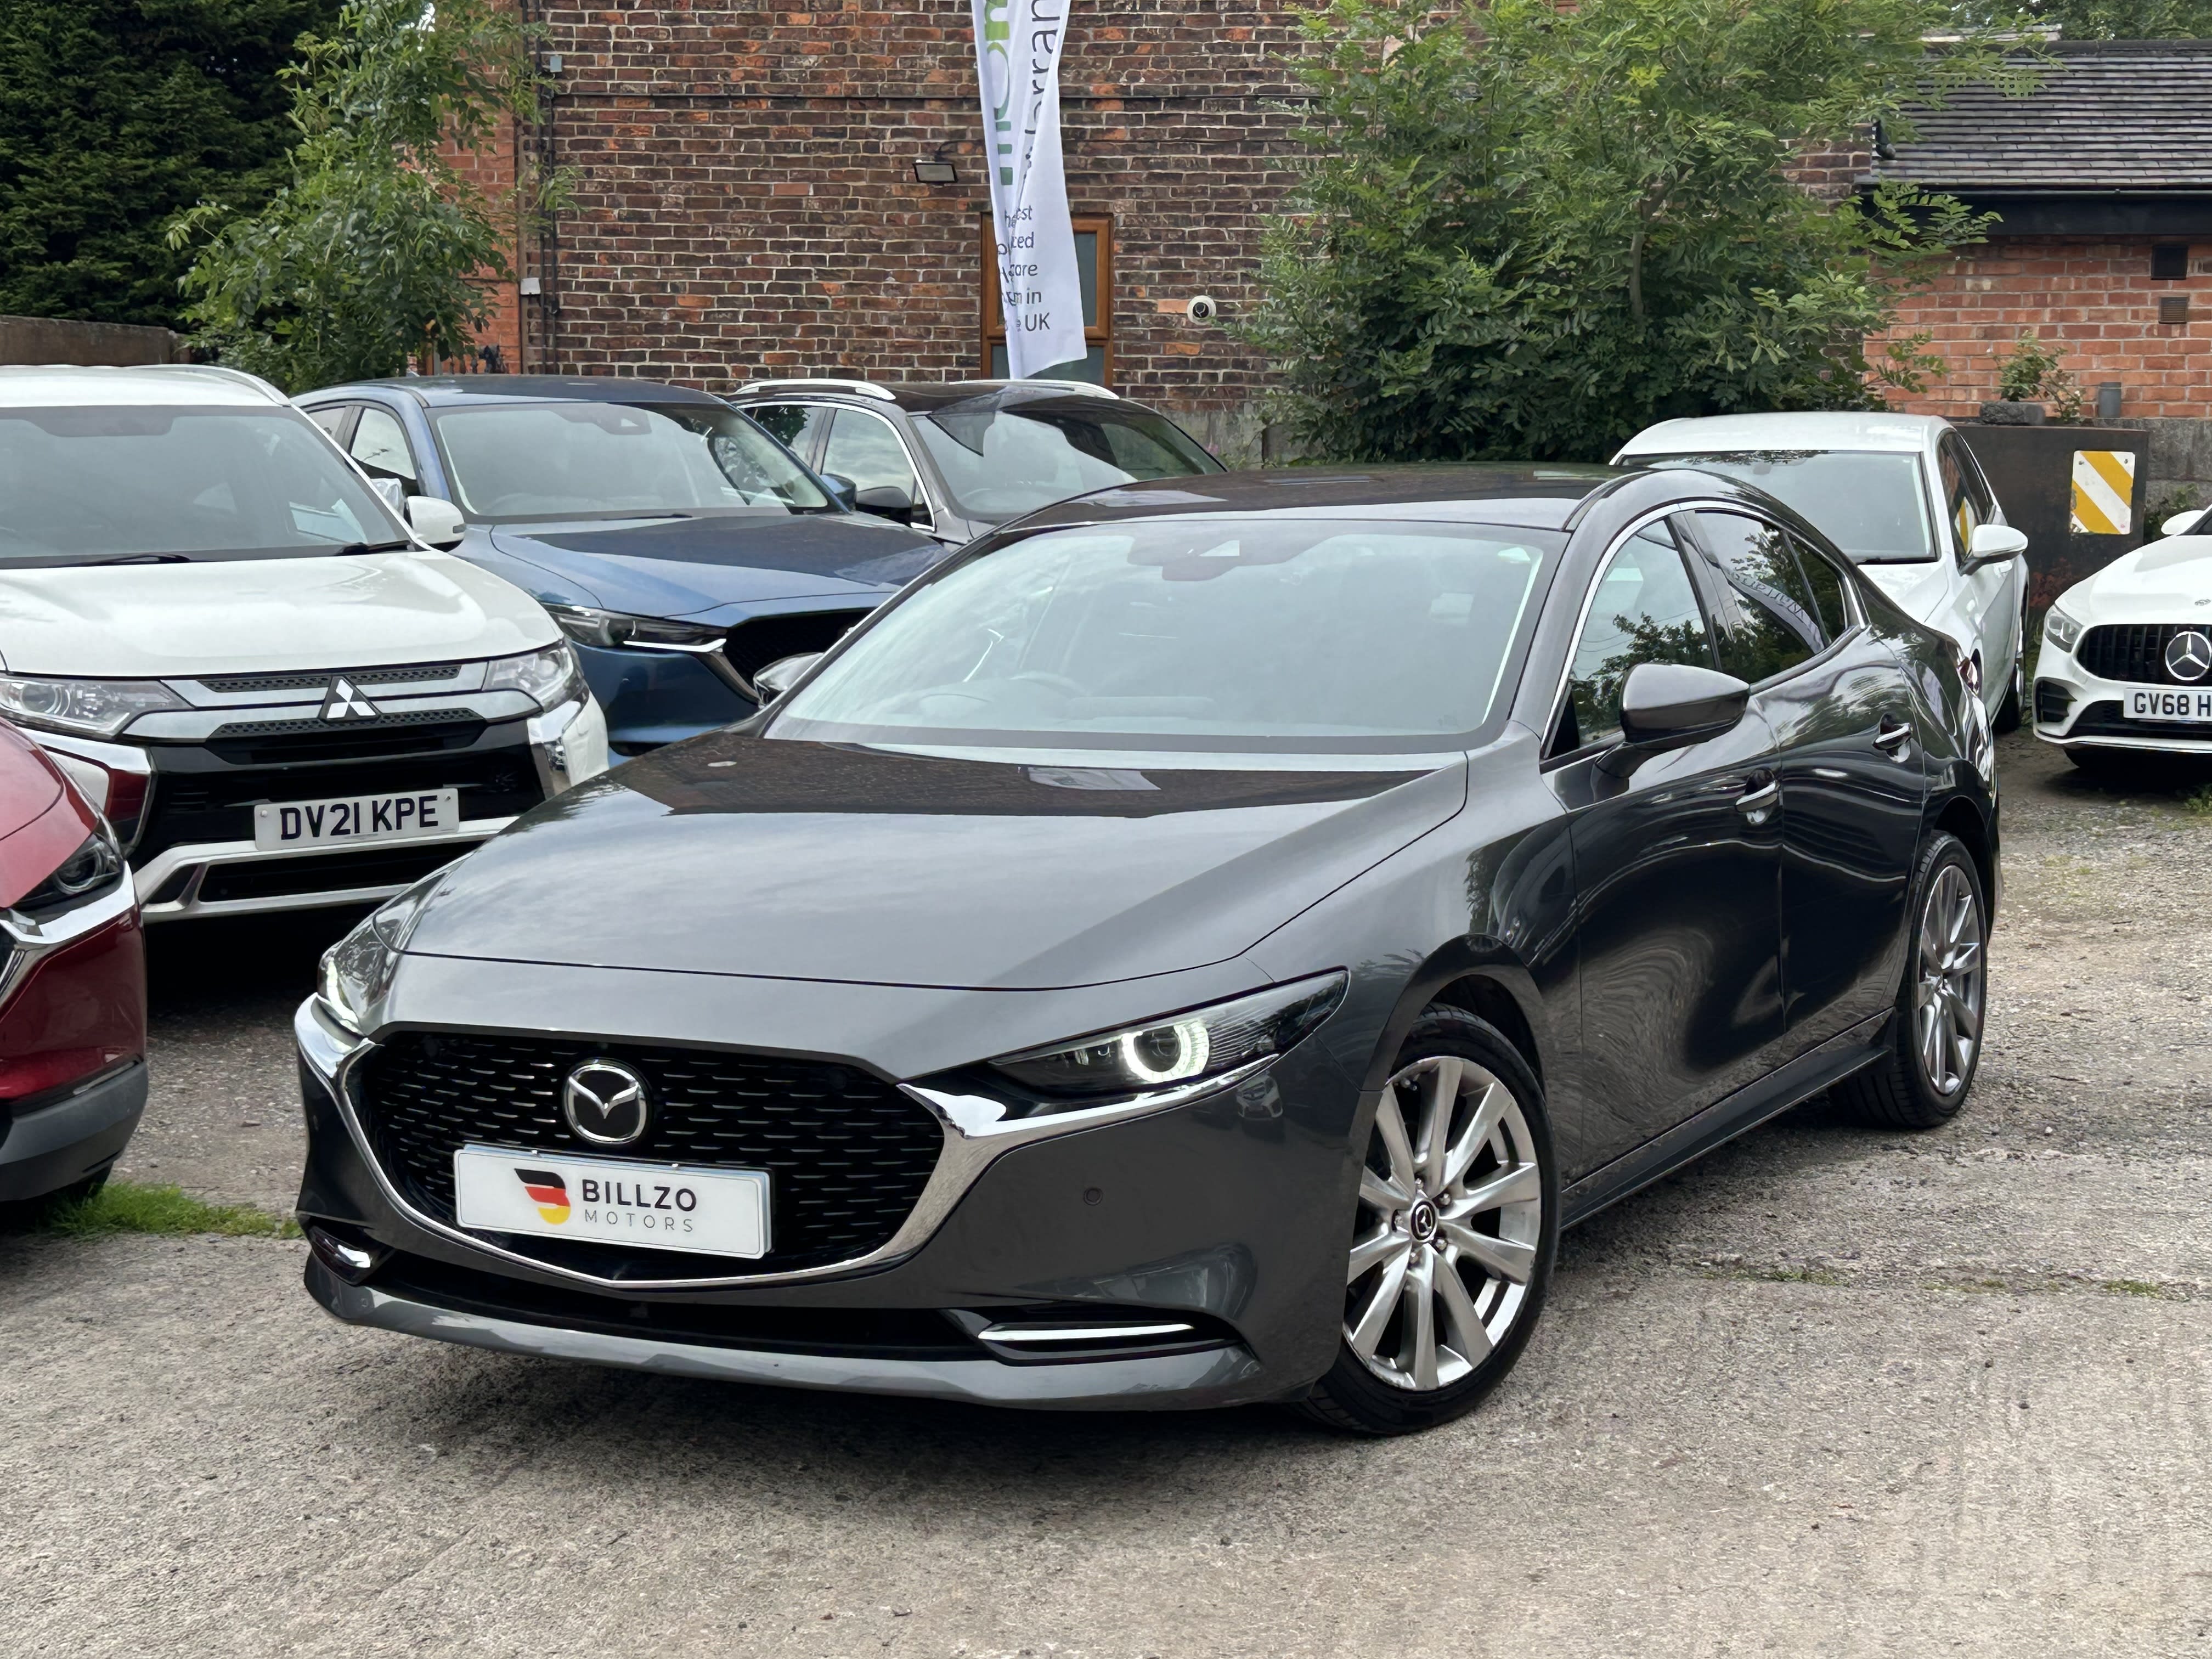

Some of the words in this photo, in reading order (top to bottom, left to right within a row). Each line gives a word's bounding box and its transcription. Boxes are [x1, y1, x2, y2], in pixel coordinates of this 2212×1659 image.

[1027, 287, 1041, 304] in
[1025, 312, 1050, 331] UK
[2134, 692, 2190, 715] GV68
[280, 802, 360, 840] DV21
[372, 795, 438, 832] KPE
[582, 1178, 697, 1212] BILLZO
[584, 1209, 694, 1233] MOTORS
